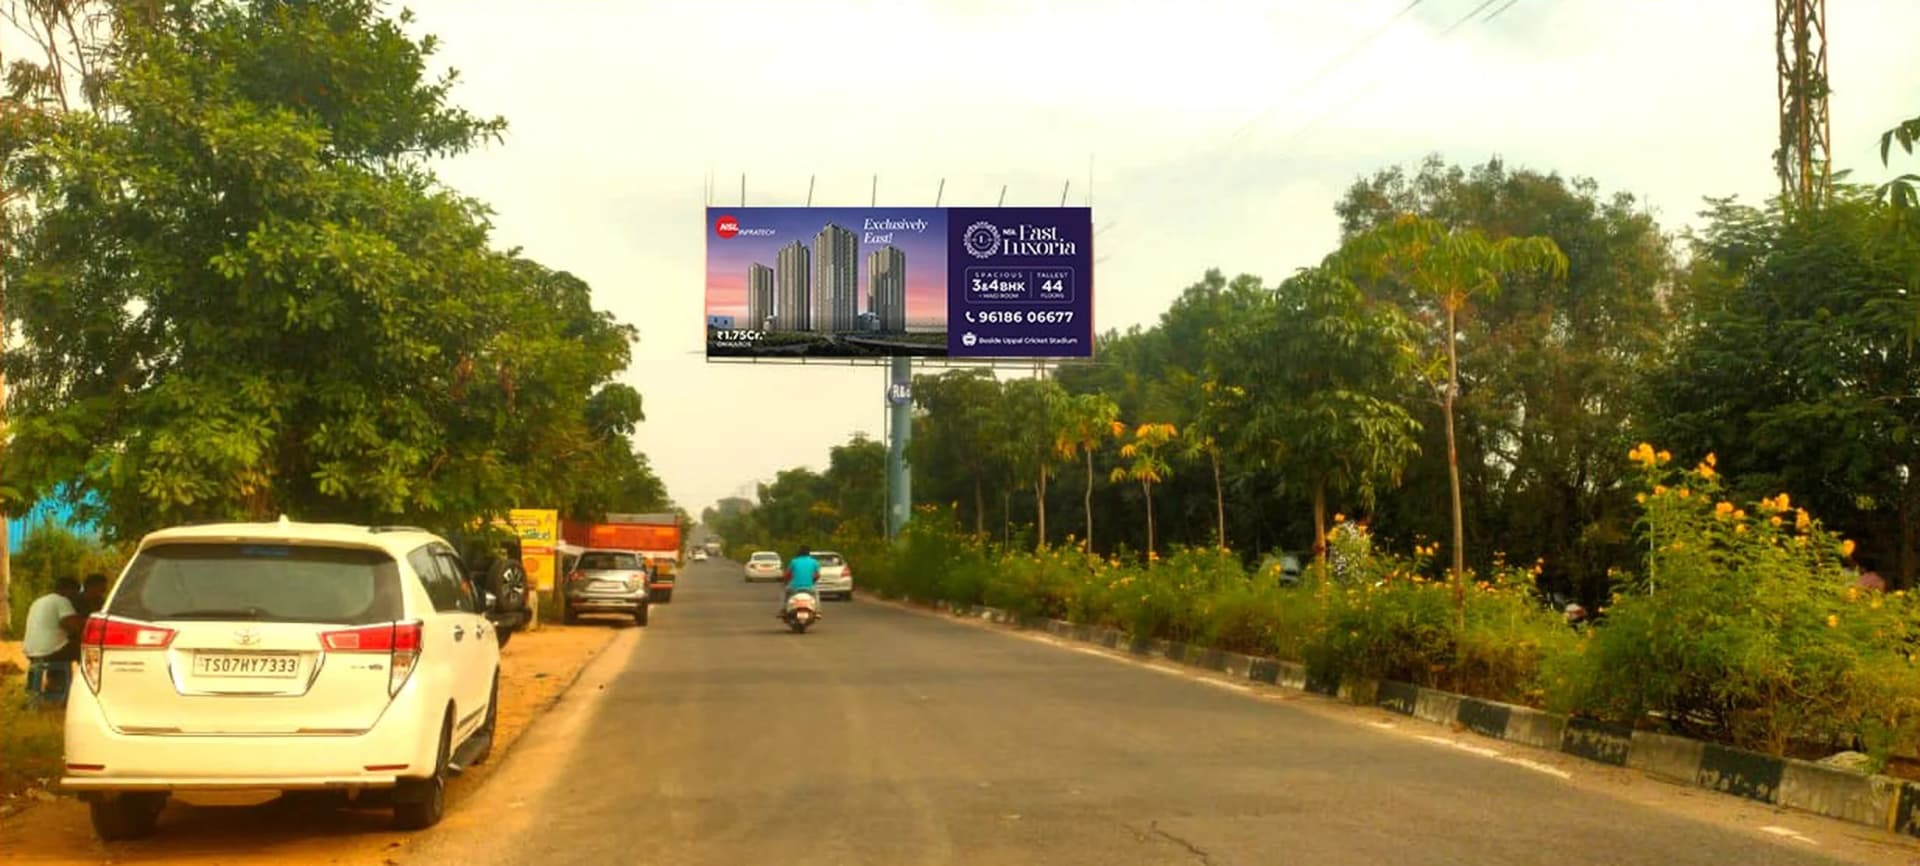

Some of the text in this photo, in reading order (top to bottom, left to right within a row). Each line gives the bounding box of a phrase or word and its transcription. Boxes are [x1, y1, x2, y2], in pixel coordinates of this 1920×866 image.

[720, 223, 739, 231] NSL
[863, 218, 929, 233] Exclusively
[738, 228, 776, 236] INFRATECH
[863, 232, 893, 244] East!
[1019, 225, 1057, 240] East
[1003, 239, 1076, 255] Luxoria
[1041, 280, 1063, 292] 44
[978, 311, 1073, 323] 96186 06677
[202, 658, 297, 674] TS07HY7333
